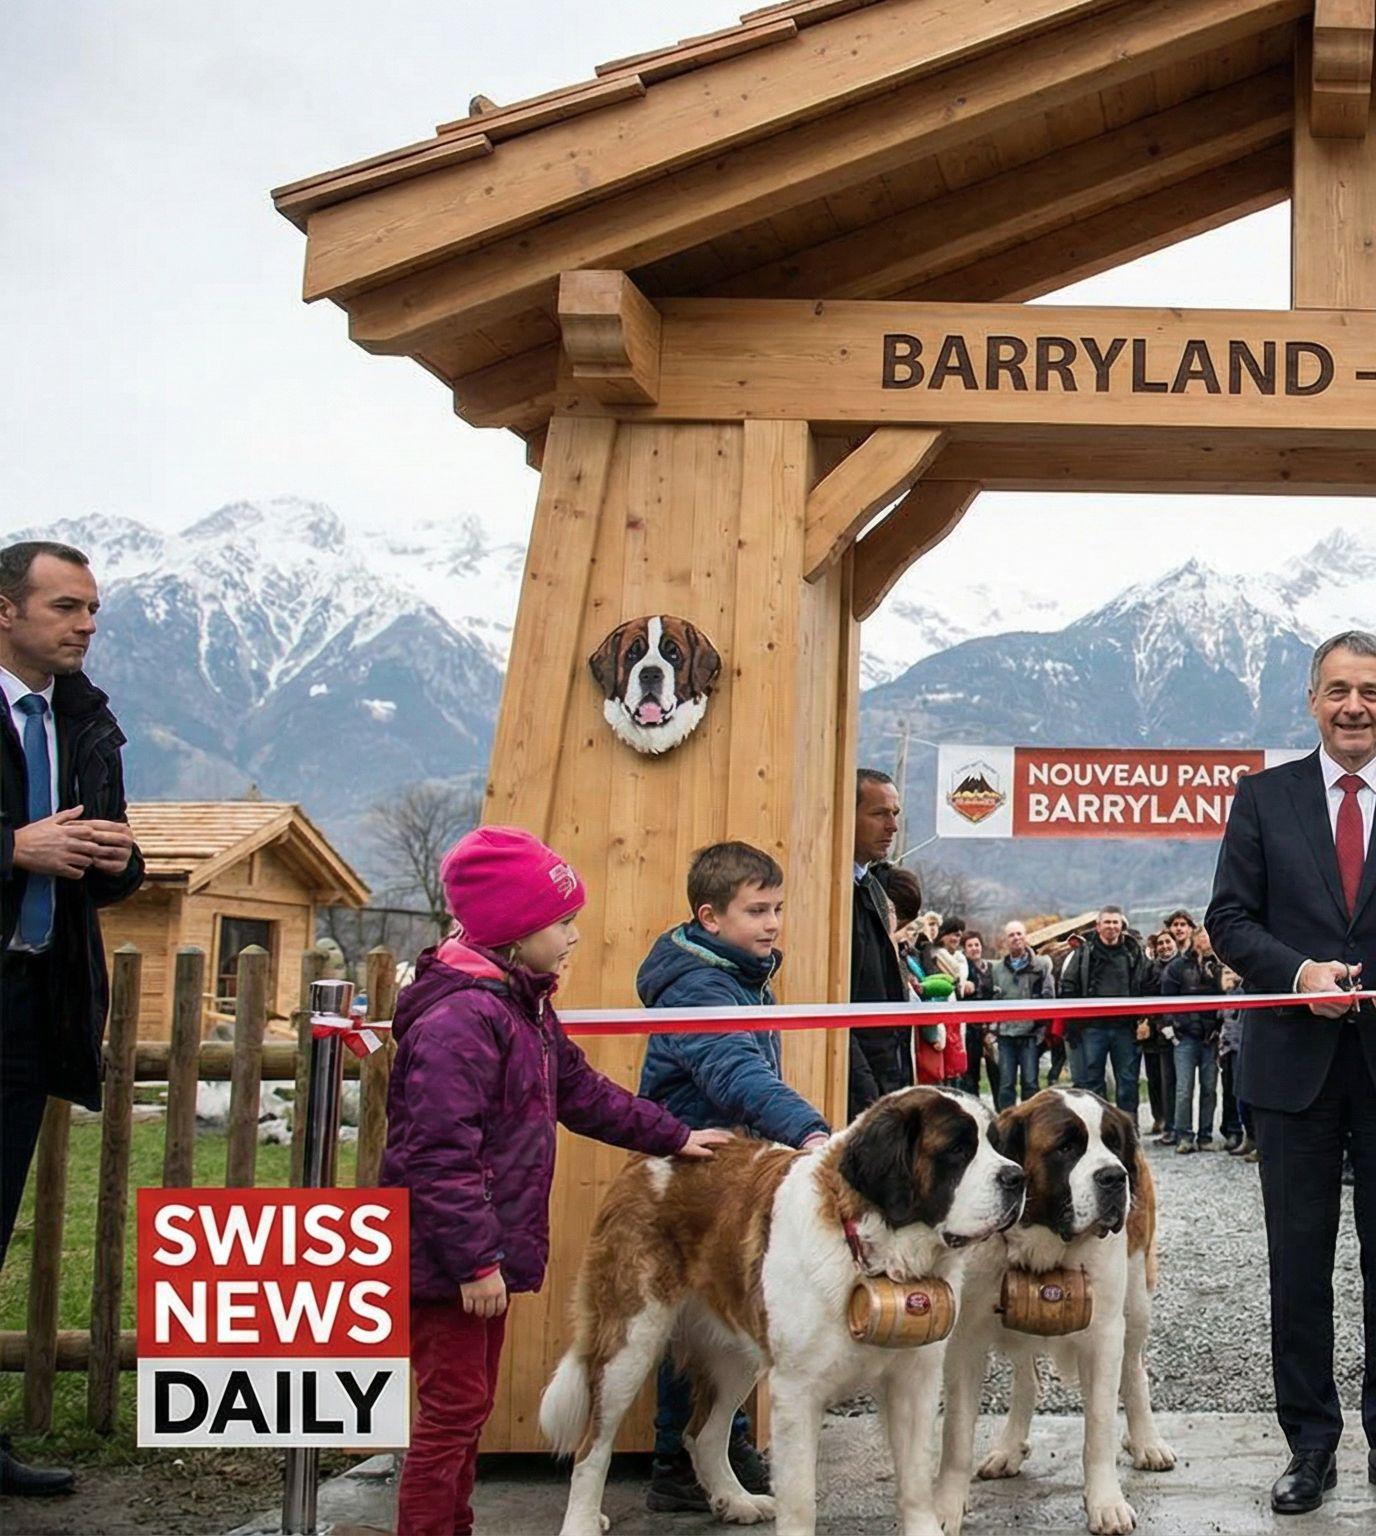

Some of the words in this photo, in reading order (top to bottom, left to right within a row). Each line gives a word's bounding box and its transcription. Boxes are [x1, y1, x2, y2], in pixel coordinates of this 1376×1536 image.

[881, 334, 1334, 396] BARRYLAND
[1028, 763, 1168, 787] NOUVEAU
[1178, 764, 1251, 787] PARC
